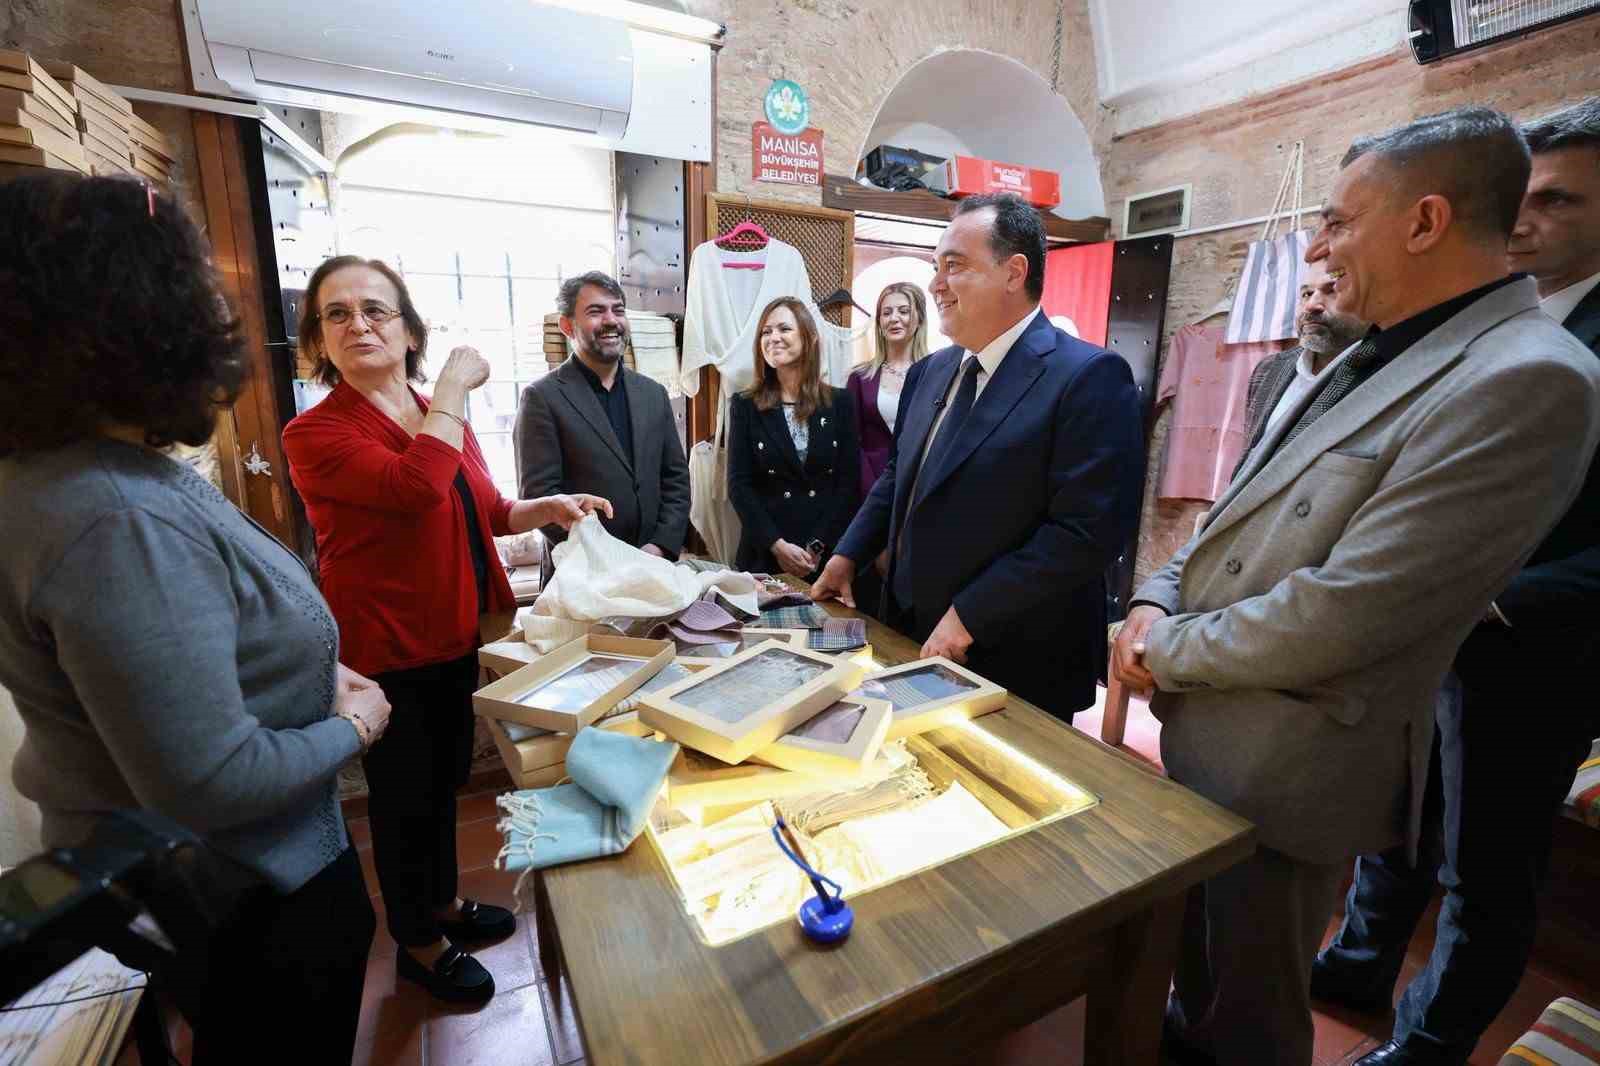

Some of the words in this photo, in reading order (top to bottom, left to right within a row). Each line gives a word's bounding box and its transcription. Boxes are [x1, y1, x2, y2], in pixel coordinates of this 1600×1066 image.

[761, 136, 818, 157] MANİSA
[761, 153, 819, 169] BÜYÜKŞEHİR
[761, 168, 819, 184] BELEDİYESİ
